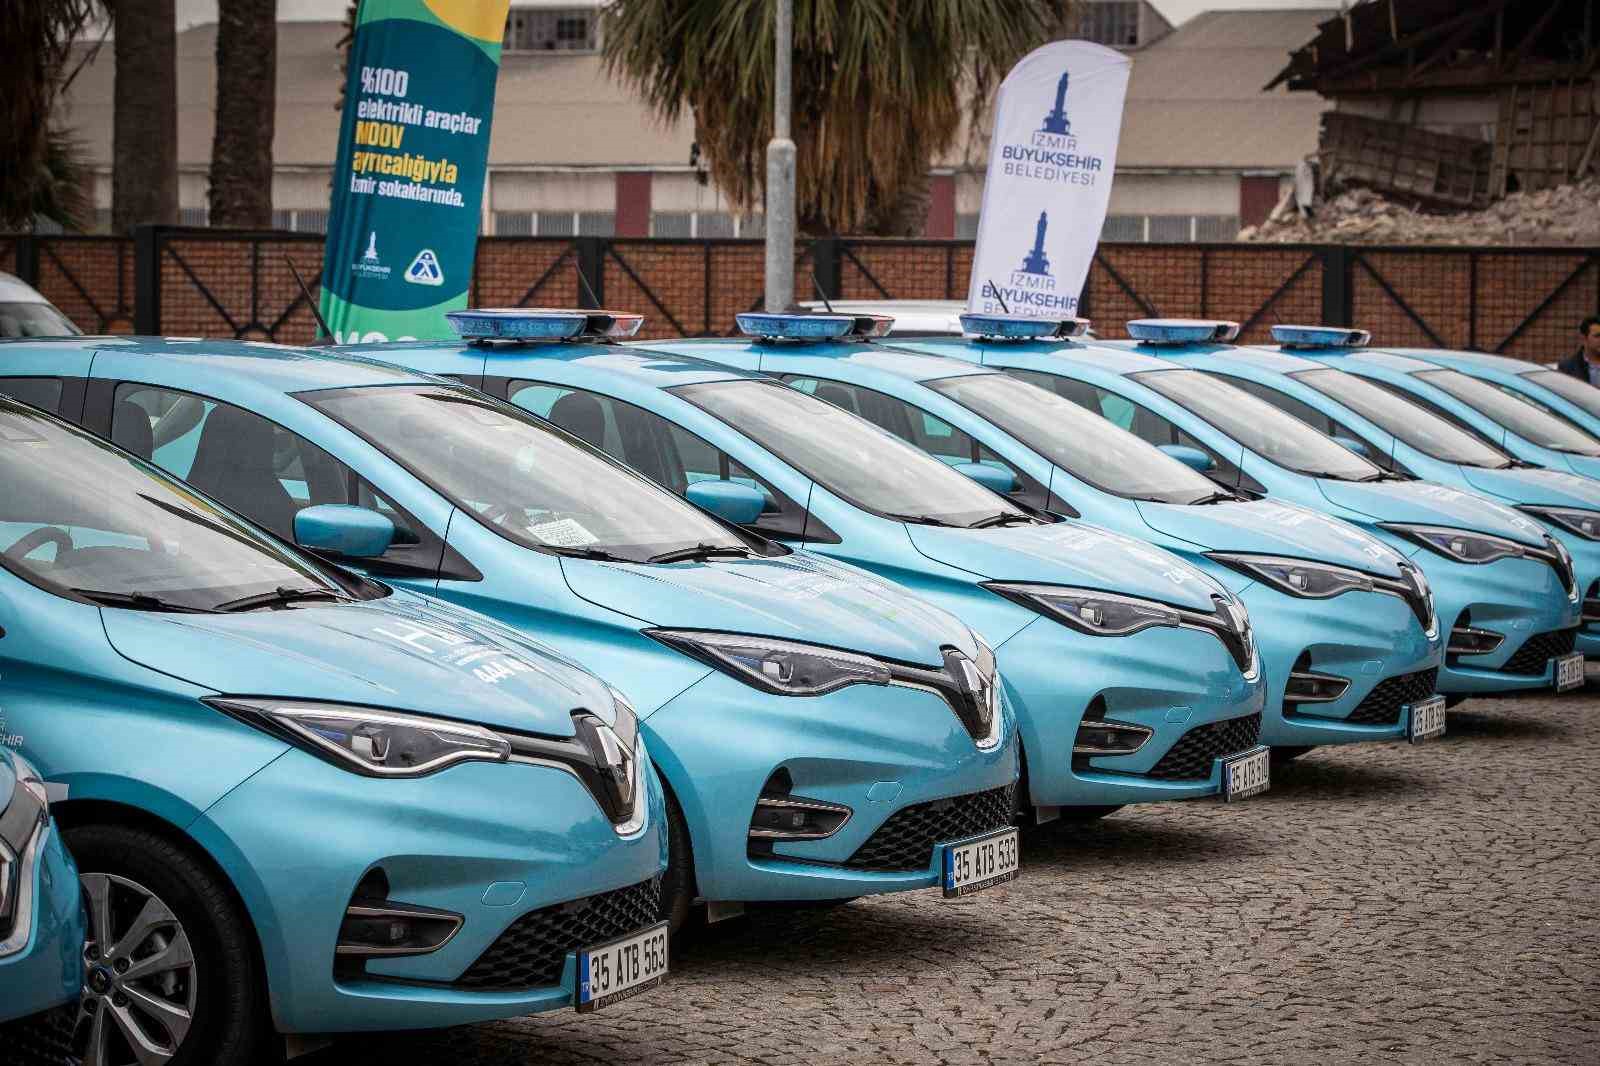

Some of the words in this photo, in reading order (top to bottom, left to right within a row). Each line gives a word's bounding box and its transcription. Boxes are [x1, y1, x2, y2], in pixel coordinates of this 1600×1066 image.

[361, 66, 409, 97] %100
[357, 98, 423, 126] elektrikli
[424, 110, 482, 135] araçlar
[352, 151, 458, 184] ayrıcalığıyla
[378, 180, 465, 208] sokaklarında.
[1232, 766, 1240, 792] 35
[1244, 760, 1255, 788] ATB
[954, 850, 969, 882] 35
[976, 844, 994, 877] ATB
[999, 837, 1015, 869] 533
[592, 953, 610, 993] 35
[616, 944, 639, 986] ATB
[644, 934, 665, 975] 563
